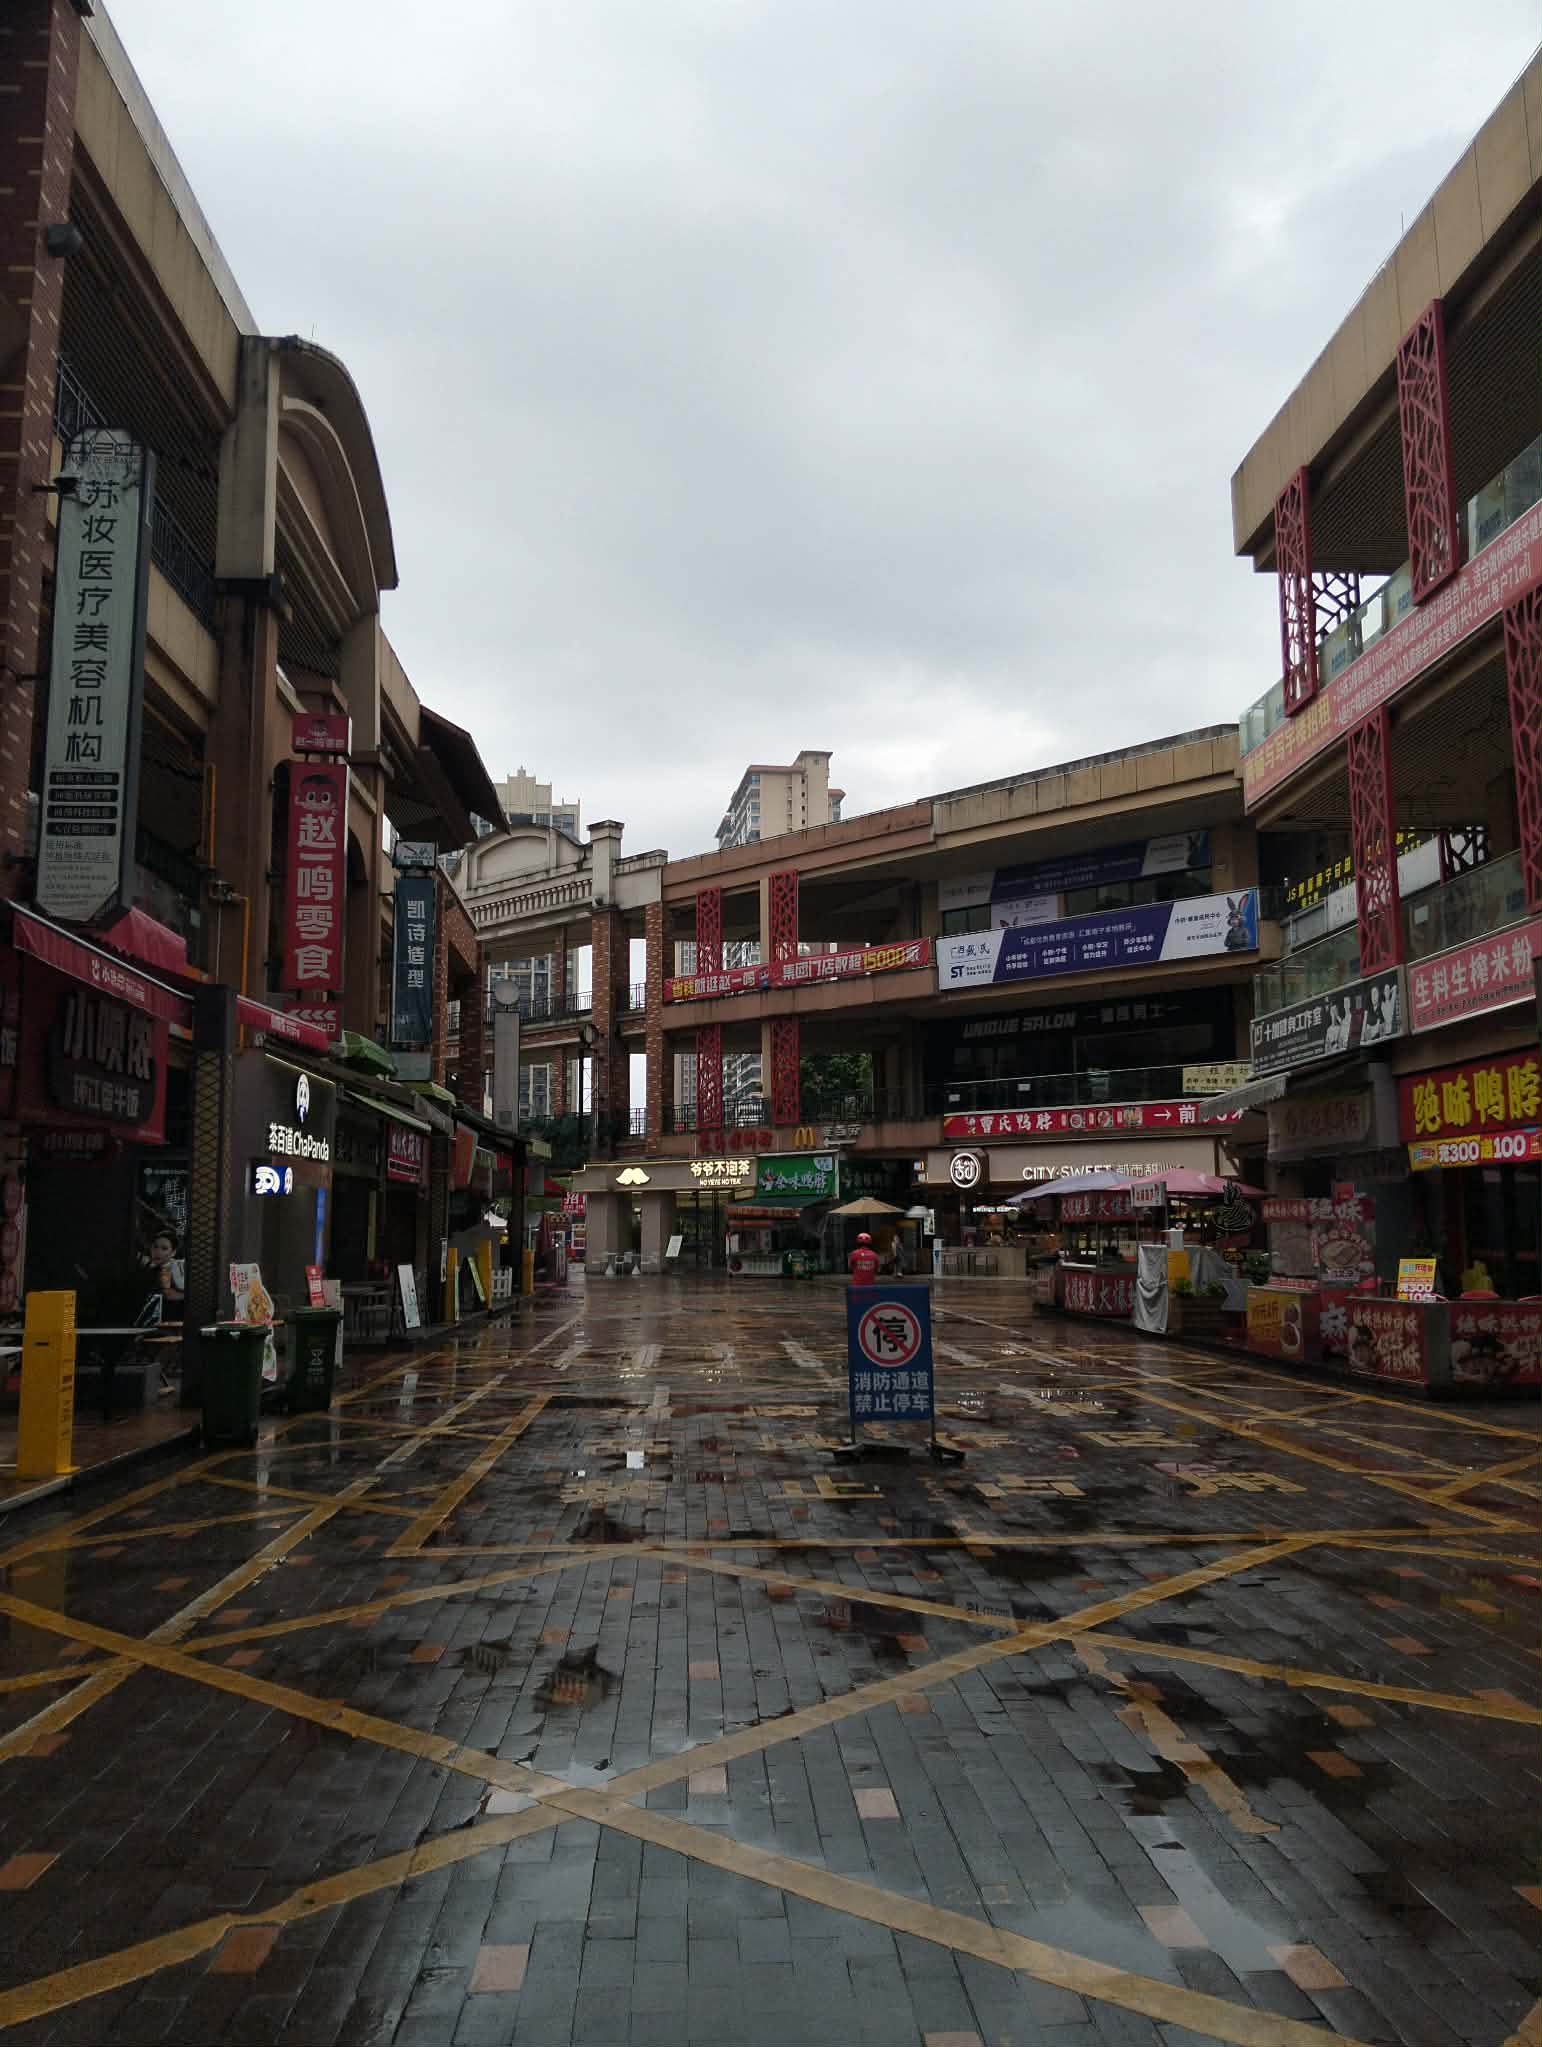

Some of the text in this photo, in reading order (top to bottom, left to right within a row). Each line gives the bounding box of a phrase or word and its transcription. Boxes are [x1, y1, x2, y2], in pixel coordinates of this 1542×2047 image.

[64, 480, 120, 765] 苏妆医疗美容机构
[294, 813, 337, 979] 赵一鸣零食
[951, 965, 964, 978] ST
[1415, 936, 1533, 1009] 生料生榨米粉
[1021, 1010, 1076, 1032] SALON
[1414, 1059, 1541, 1134] 绝味鸭脖
[690, 1160, 750, 1177] 爷爷不泡茶
[872, 1317, 908, 1353] 停
[855, 1371, 929, 1391] 消防通道
[855, 1393, 930, 1414] 禁止停车
